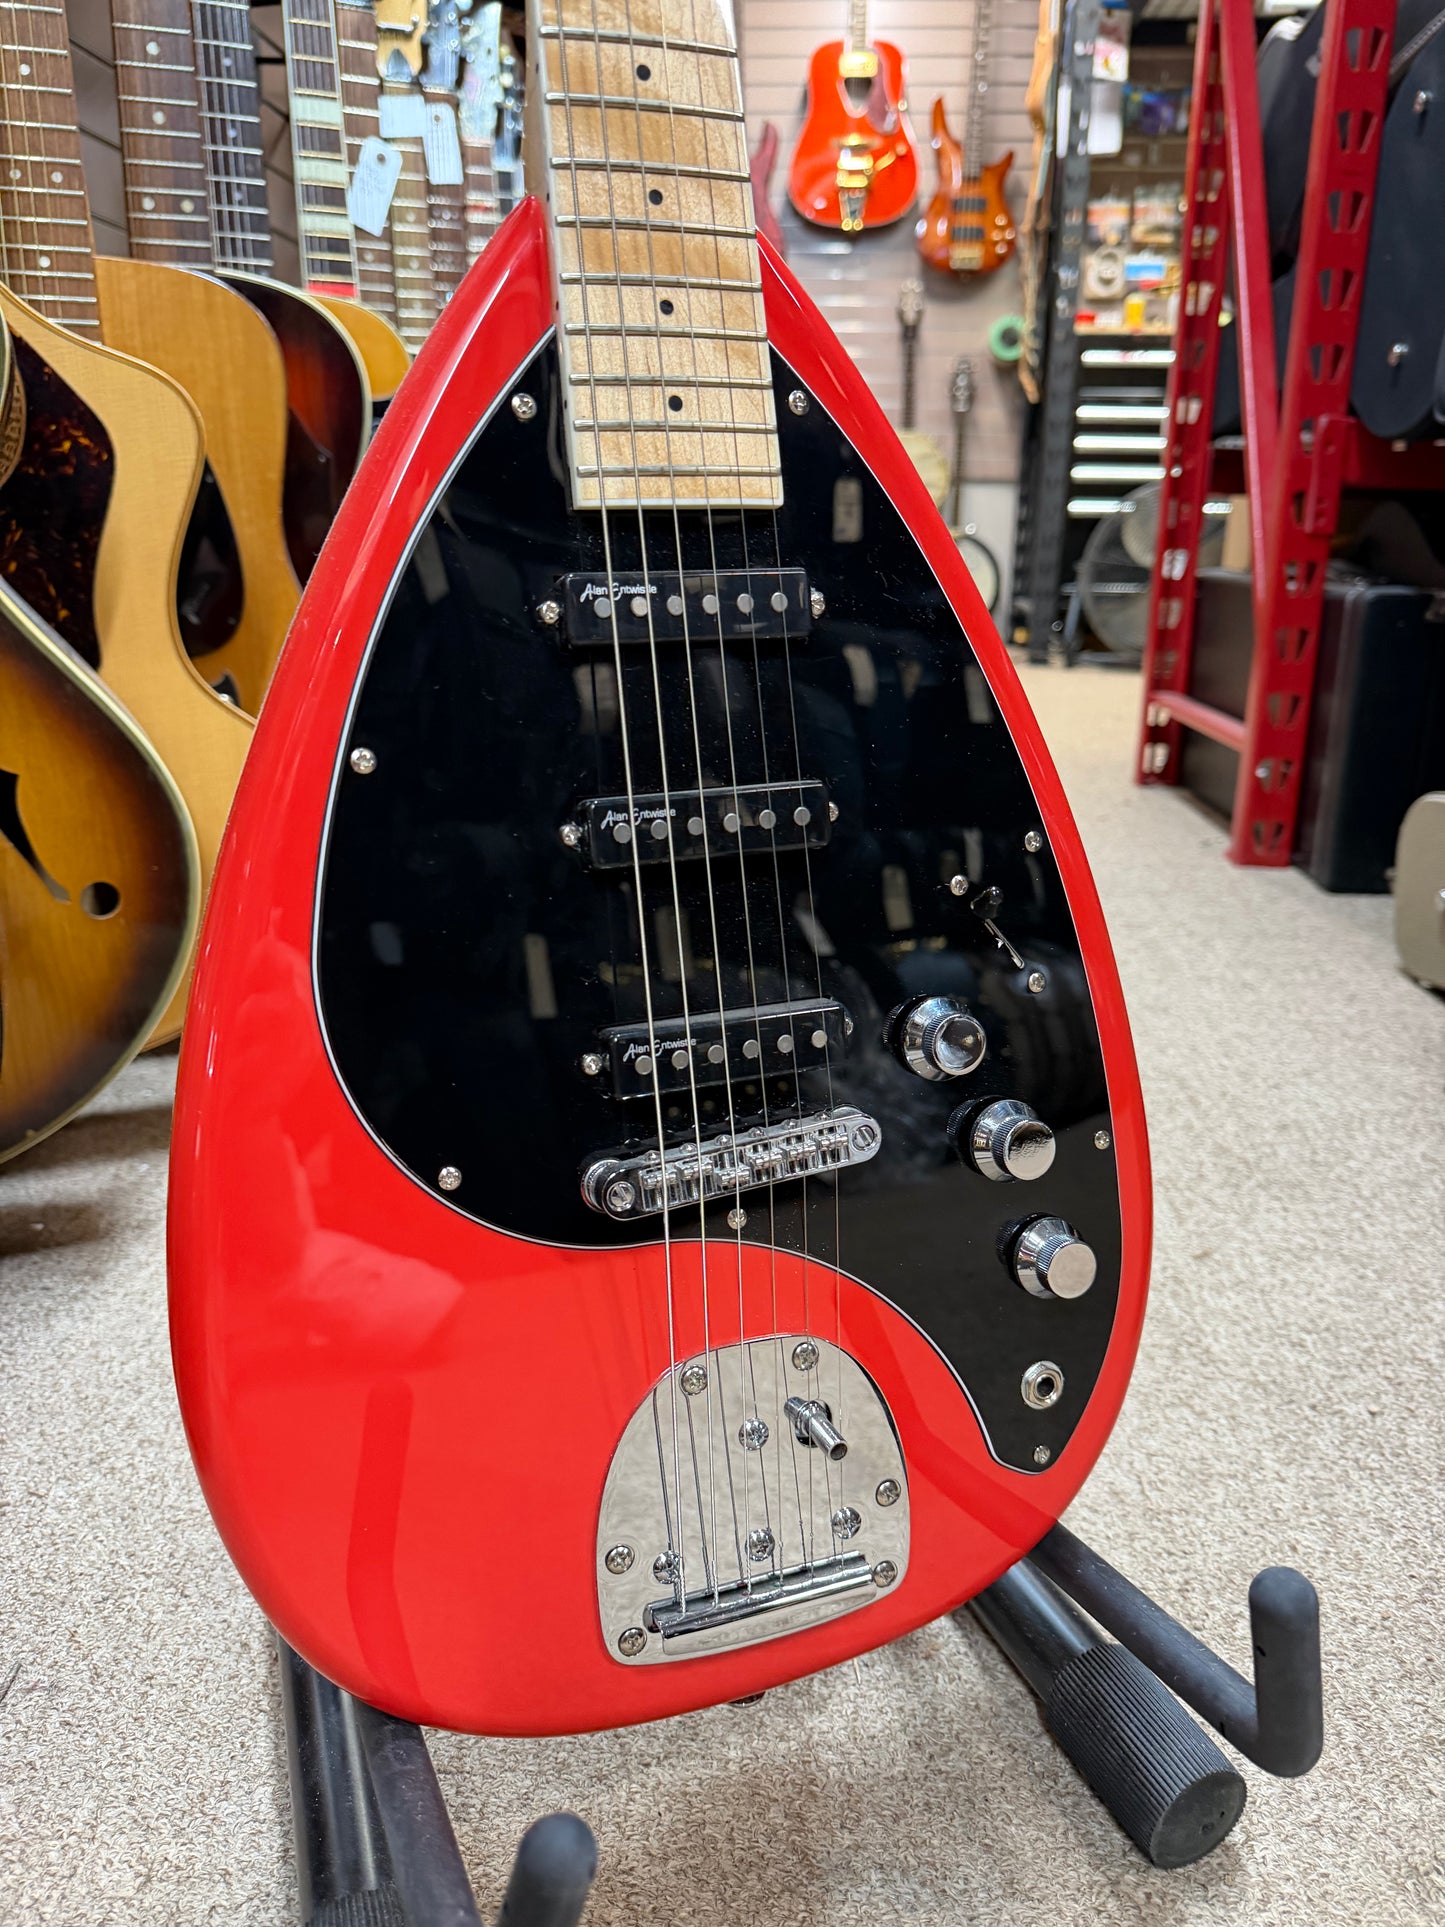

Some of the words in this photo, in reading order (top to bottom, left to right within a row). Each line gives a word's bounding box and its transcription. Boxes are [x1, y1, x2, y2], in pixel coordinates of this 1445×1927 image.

[580, 583, 609, 603] Alan
[611, 582, 657, 601] Entwisle
[600, 809, 629, 830] Alan
[631, 807, 677, 826] Entwiste
[622, 1043, 650, 1062] Alan
[653, 1038, 697, 1057] Entwiste
